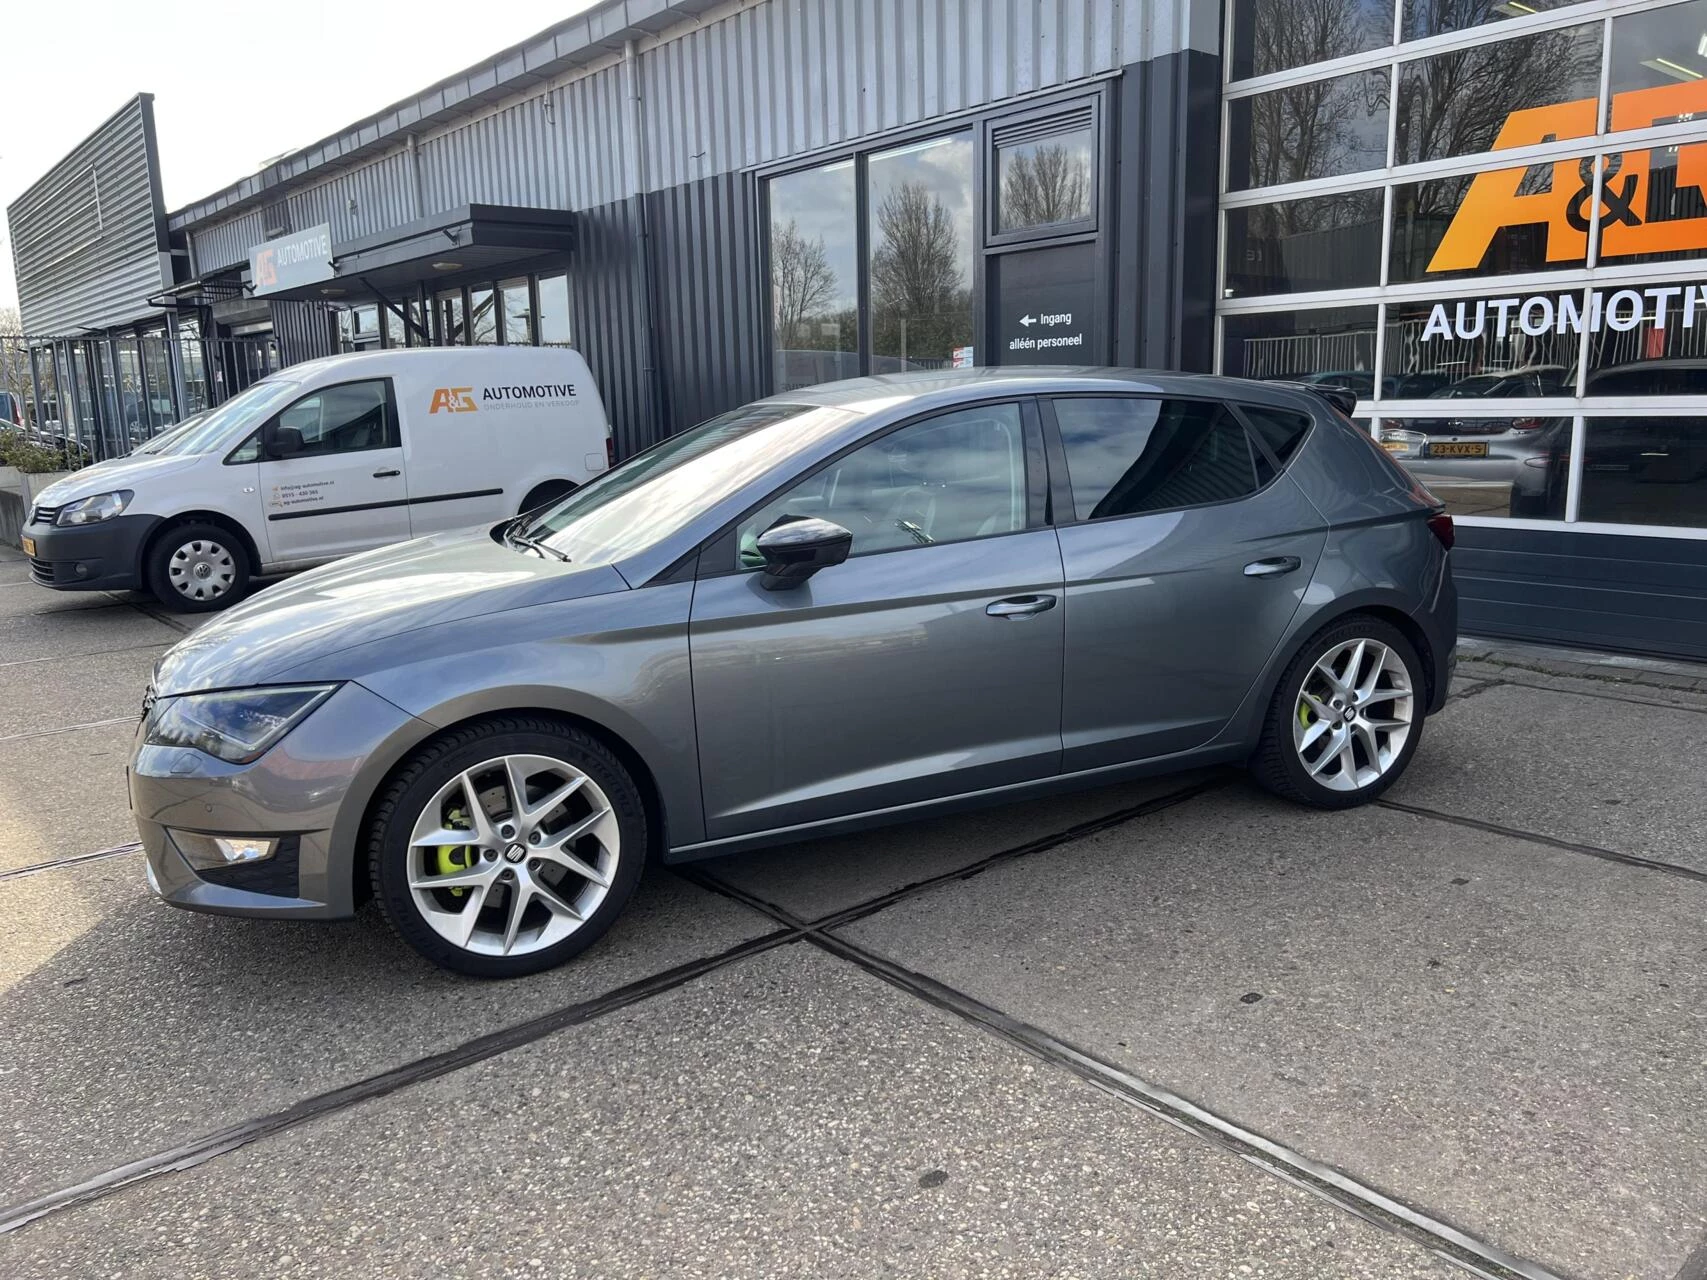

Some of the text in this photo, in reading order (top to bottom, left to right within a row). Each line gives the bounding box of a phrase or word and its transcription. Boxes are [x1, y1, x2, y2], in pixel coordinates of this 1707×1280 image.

[277, 234, 328, 267] AUTOMOTIVE
[1040, 313, 1072, 326] Ingang
[1421, 285, 1707, 342] AUTOMOTI
[1037, 333, 1082, 350] personeel
[429, 384, 577, 414] A&G AUTOMOTIVE
